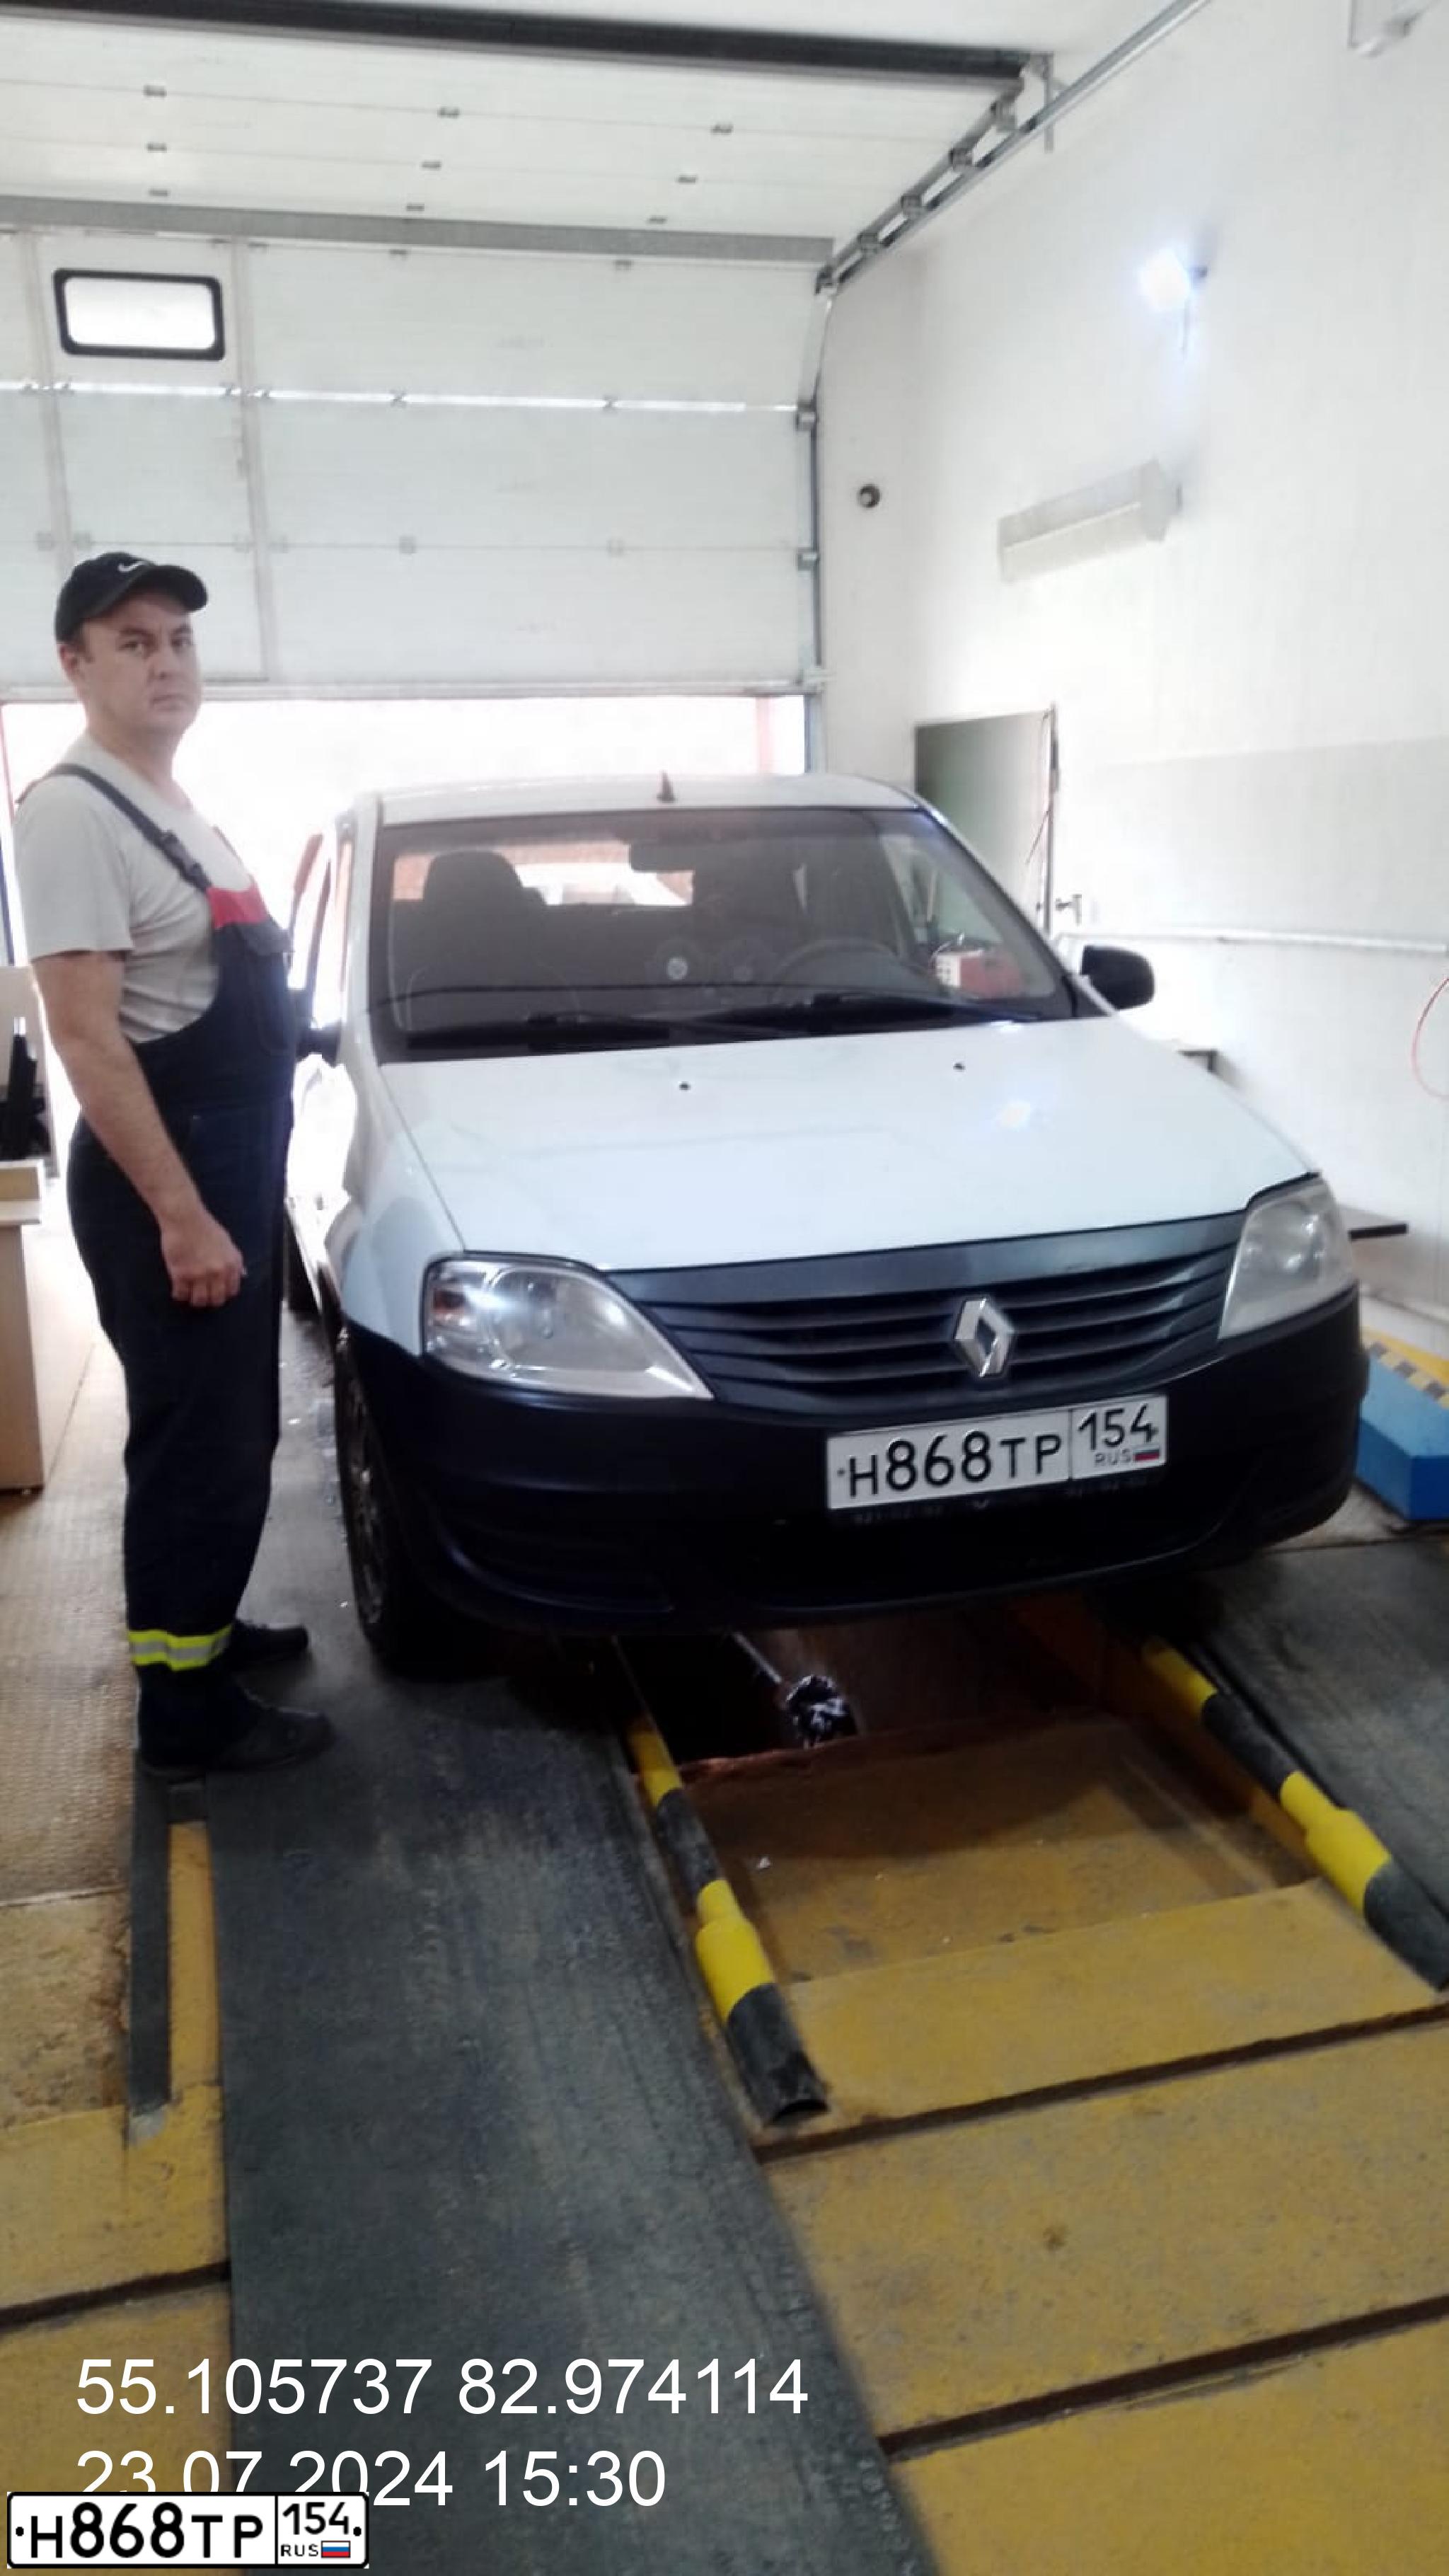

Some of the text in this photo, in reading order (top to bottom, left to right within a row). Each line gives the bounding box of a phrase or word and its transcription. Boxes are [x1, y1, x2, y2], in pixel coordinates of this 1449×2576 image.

[849, 1403, 1157, 1497] Н868ТР 154
[1095, 1449, 1132, 1467] RUS
